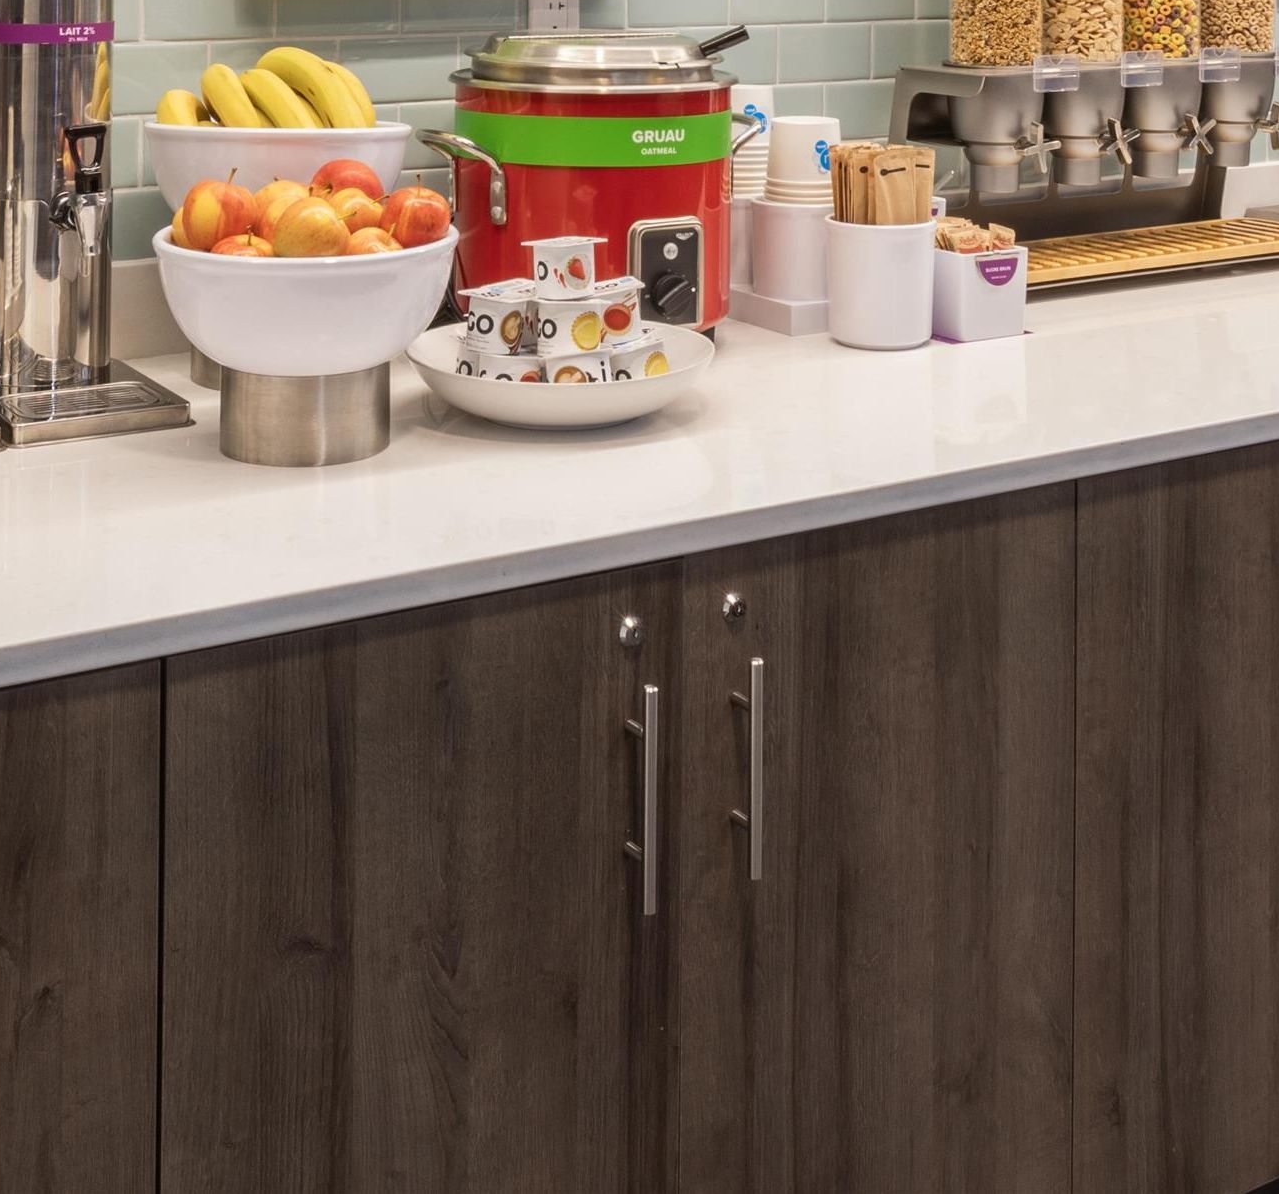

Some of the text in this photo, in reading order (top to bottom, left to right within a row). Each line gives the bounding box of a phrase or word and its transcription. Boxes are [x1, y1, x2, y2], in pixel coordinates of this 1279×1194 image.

[59, 27, 95, 36] LAIT 2%
[632, 129, 685, 143] GRUAU
[641, 147, 677, 155] OATMEAL
